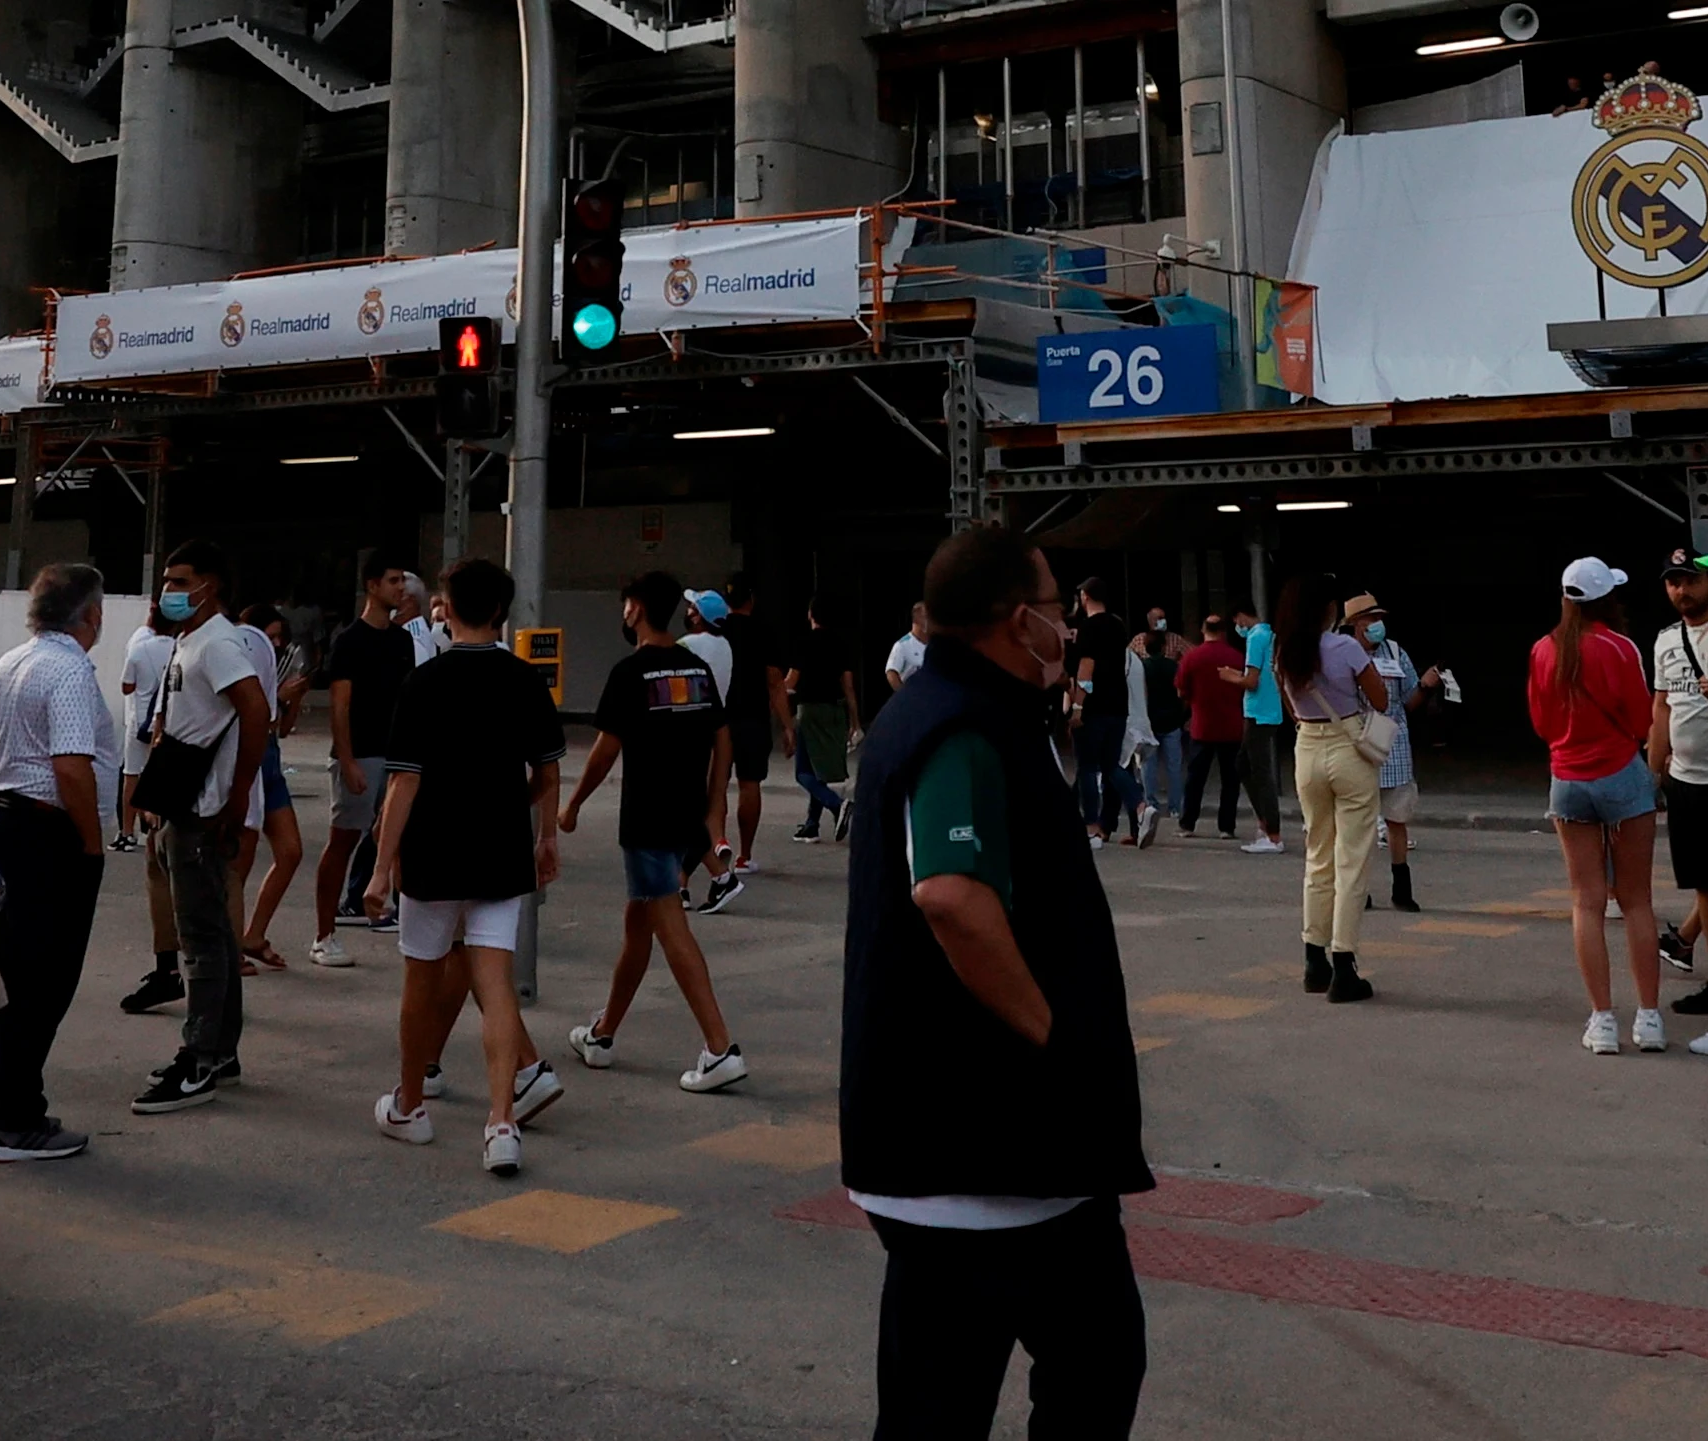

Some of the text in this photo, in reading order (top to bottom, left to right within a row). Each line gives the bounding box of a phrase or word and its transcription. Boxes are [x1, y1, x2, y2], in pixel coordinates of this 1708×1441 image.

[704, 268, 816, 296] Realmadrid
[389, 298, 477, 323] Realmadrid
[250, 313, 331, 337] Realmadrid
[118, 326, 195, 349] Realmadrid
[1045, 346, 1081, 358] Puerta
[1088, 345, 1165, 408] 26
